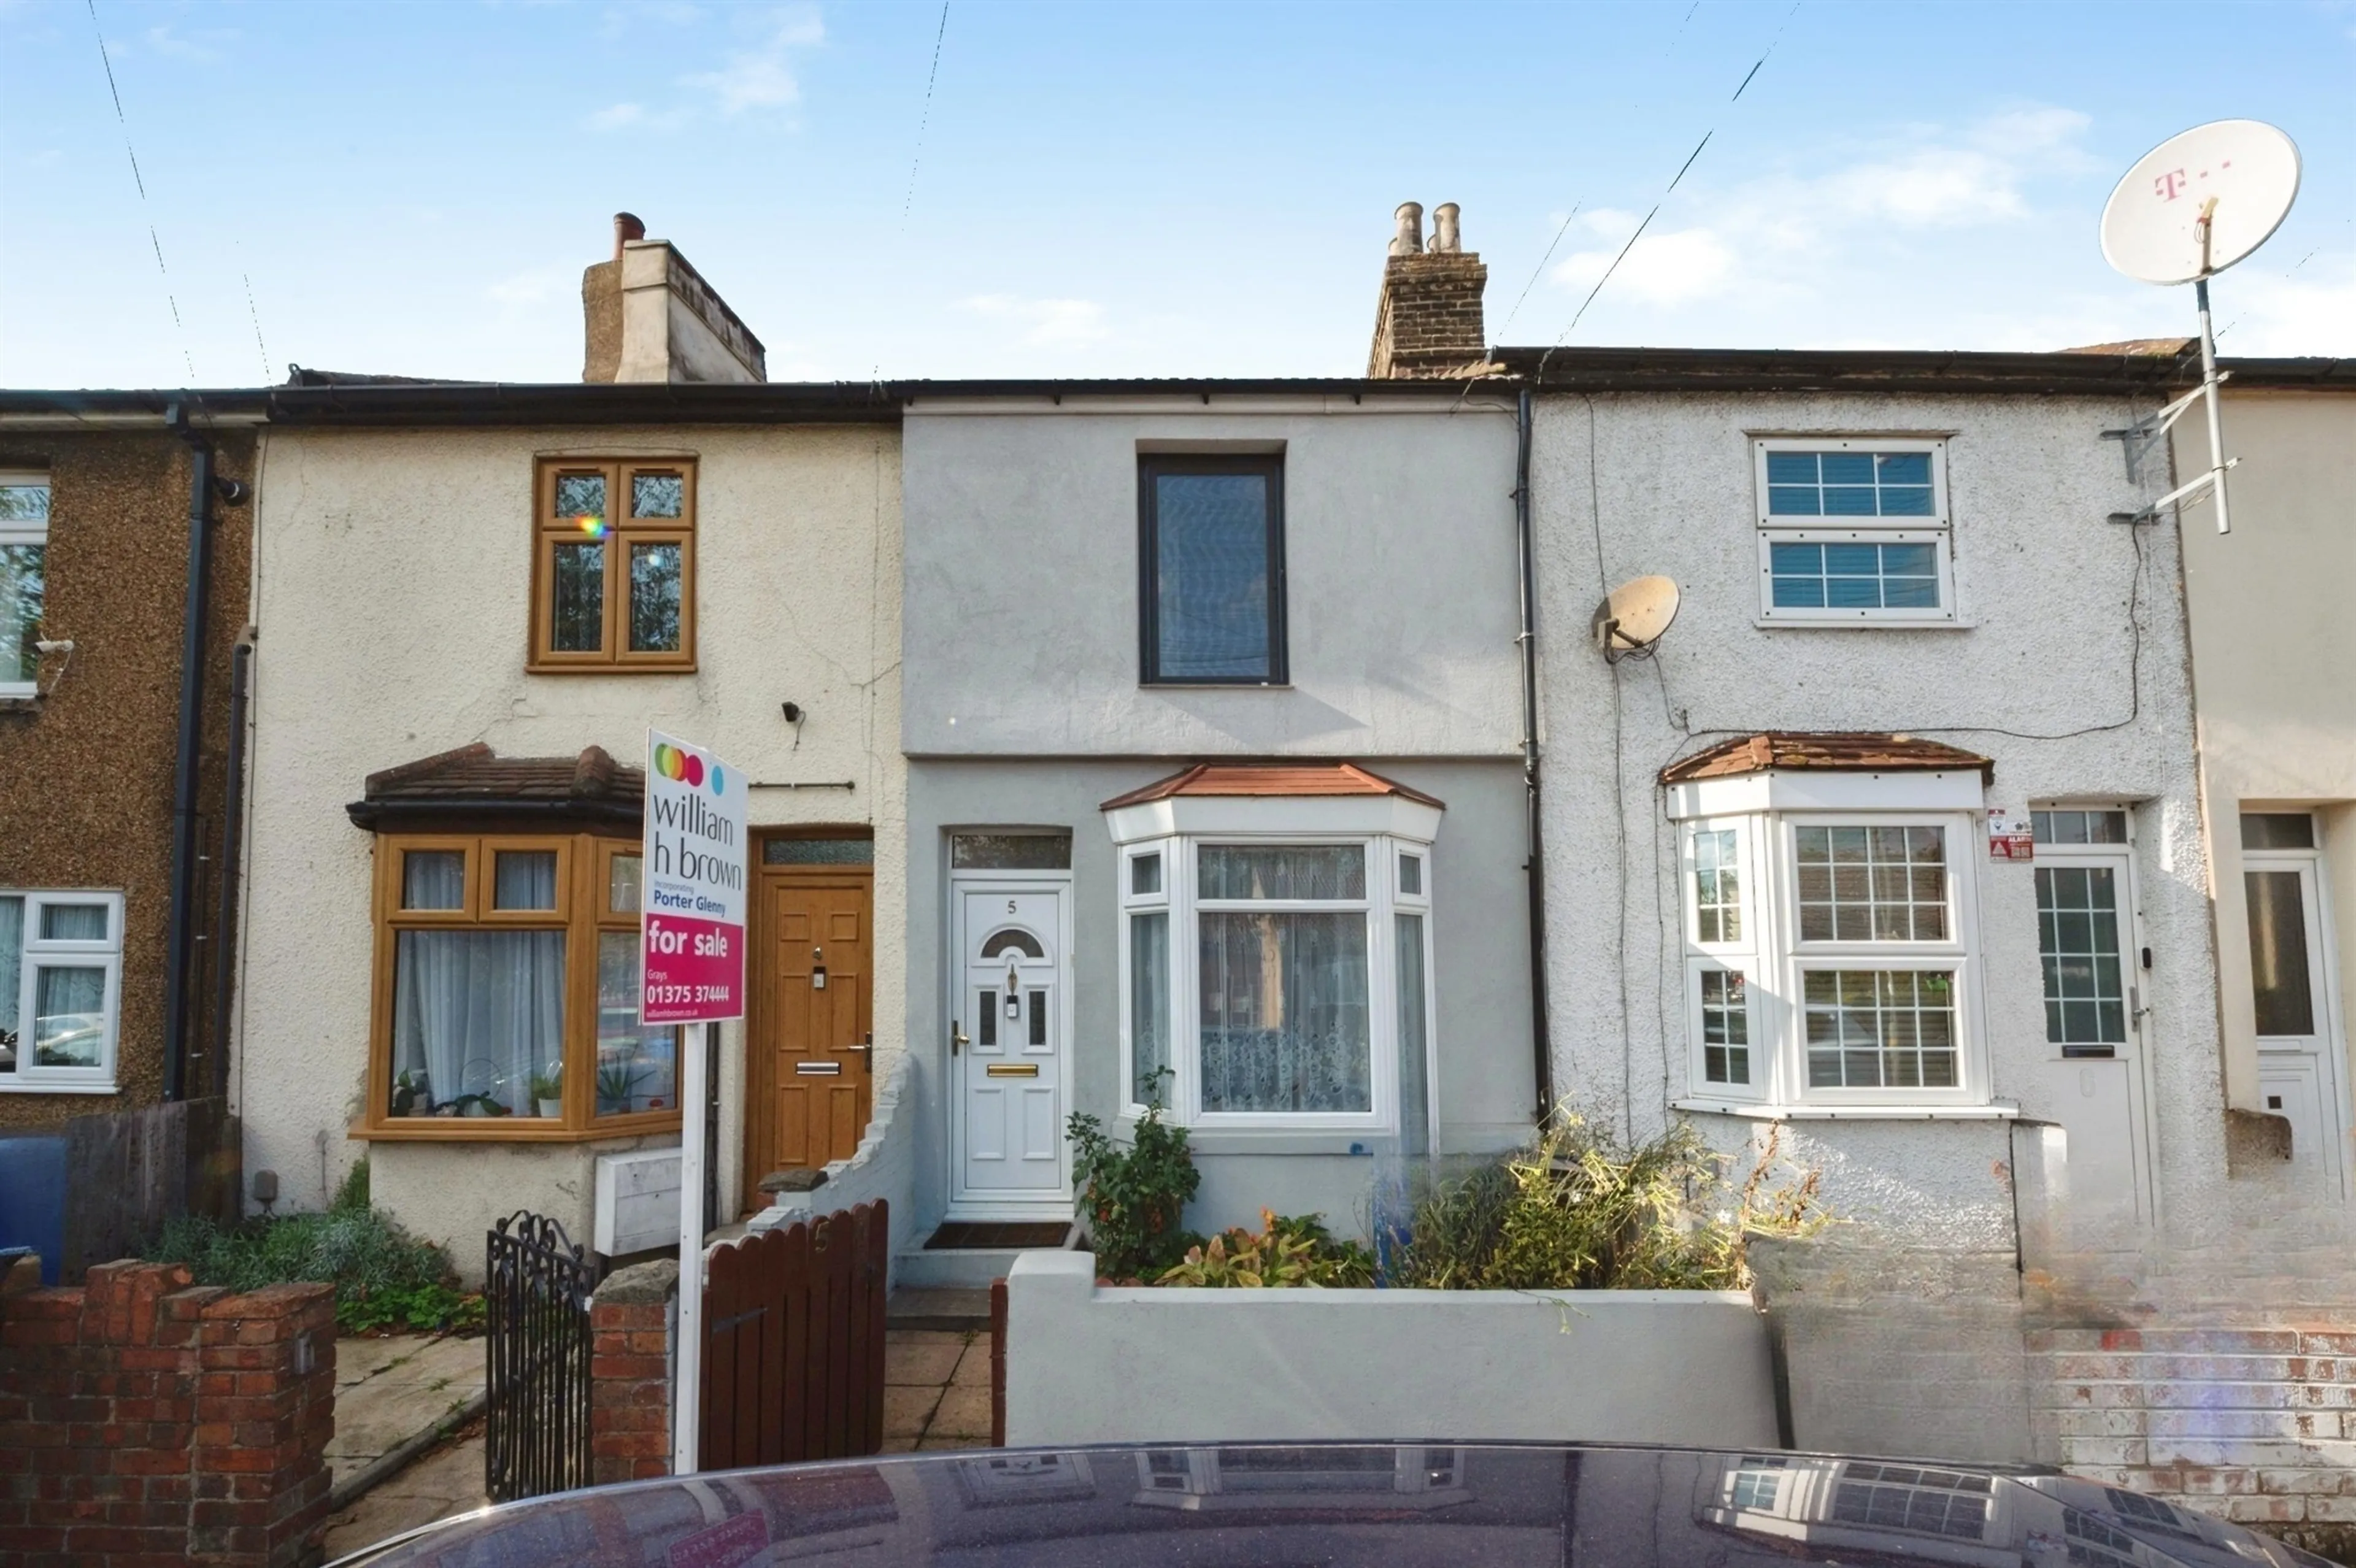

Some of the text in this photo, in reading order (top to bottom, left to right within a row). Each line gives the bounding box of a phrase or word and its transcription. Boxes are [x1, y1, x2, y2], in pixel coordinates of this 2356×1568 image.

[653, 793, 733, 847] william
[654, 831, 742, 891] h brown
[654, 879, 695, 896] incorporating
[654, 890, 726, 918] Porter Glenny
[1007, 900, 1017, 914] 5
[648, 920, 728, 958] for sale
[647, 969, 668, 983] Grays
[647, 985, 730, 1004] 01375 374444
[815, 1221, 830, 1253] 5
